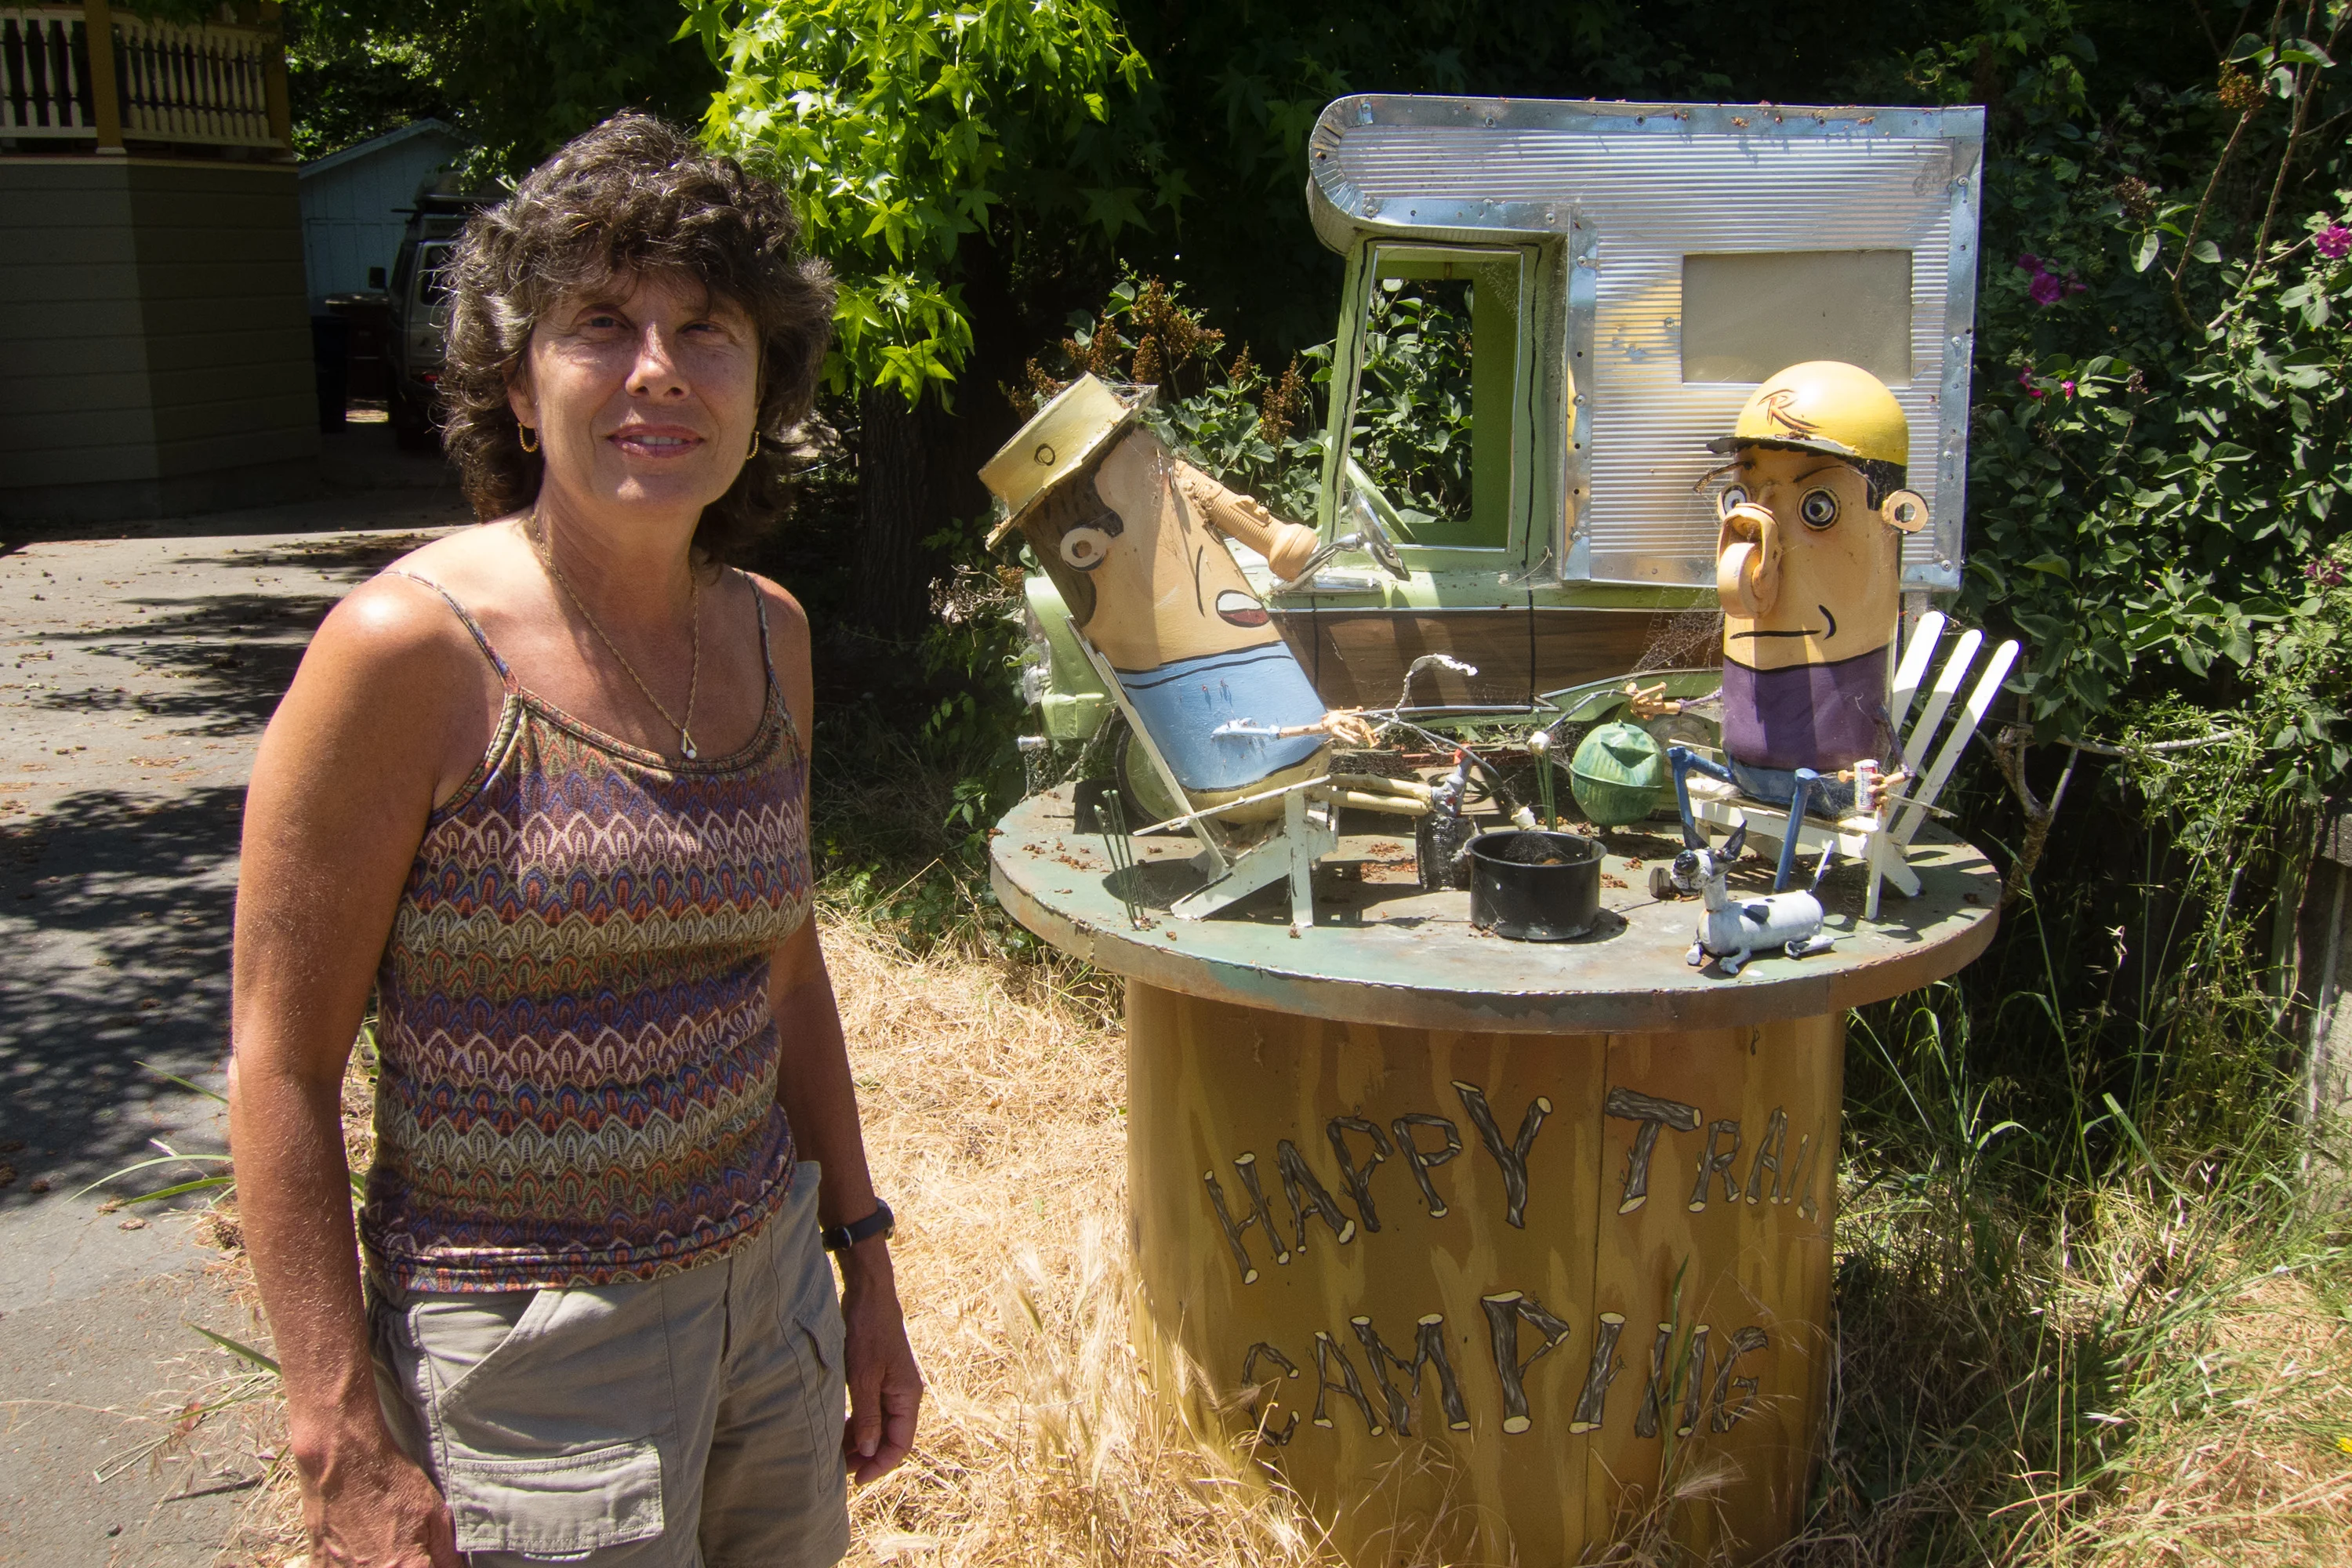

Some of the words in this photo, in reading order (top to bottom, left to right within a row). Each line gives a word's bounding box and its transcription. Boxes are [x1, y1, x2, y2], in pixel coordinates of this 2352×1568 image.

[1757, 389, 1821, 434] R
[1203, 1080, 1553, 1285] HAPPY
[1241, 1290, 1769, 1446] CAMPING
